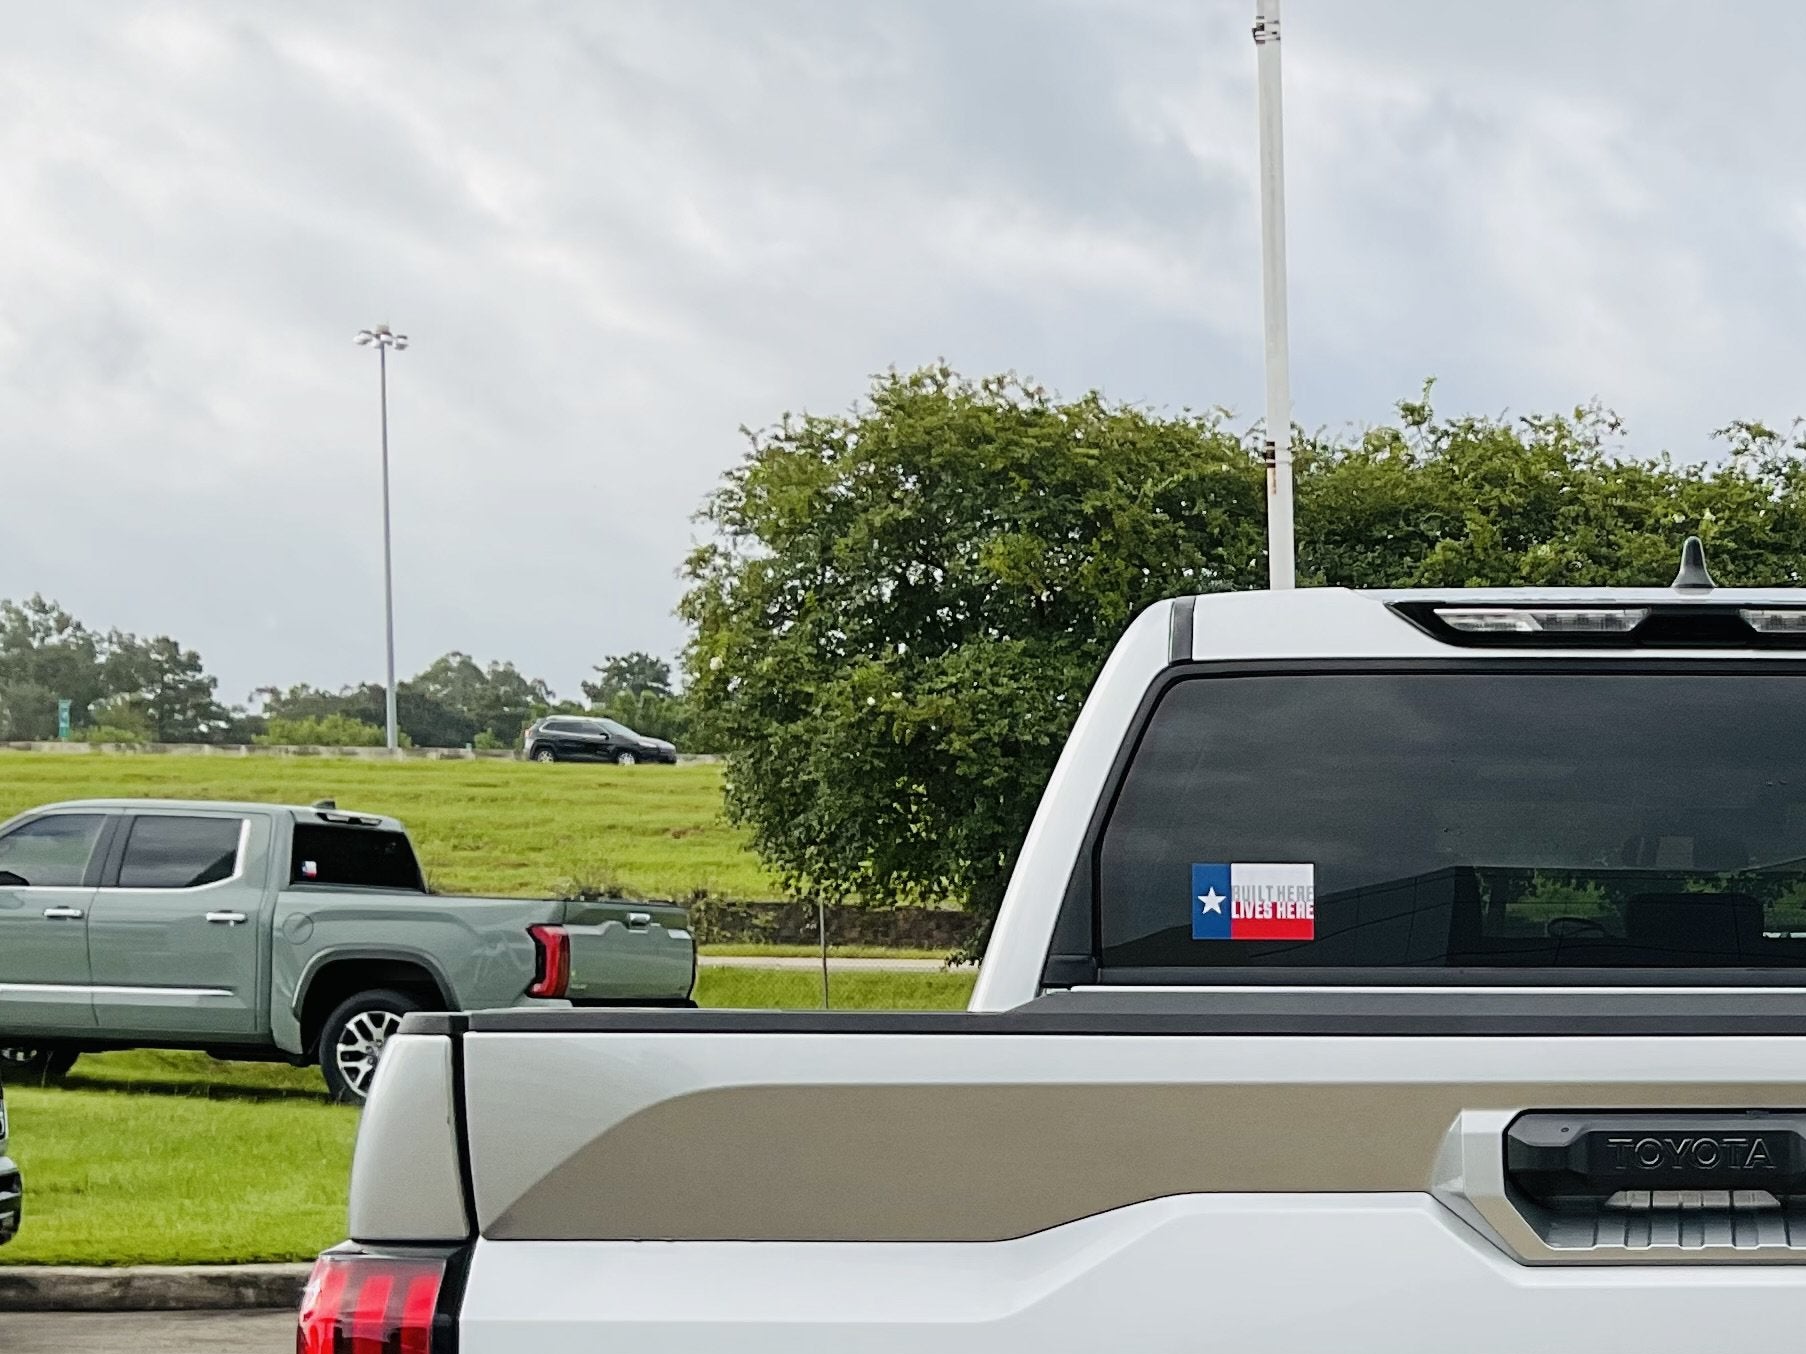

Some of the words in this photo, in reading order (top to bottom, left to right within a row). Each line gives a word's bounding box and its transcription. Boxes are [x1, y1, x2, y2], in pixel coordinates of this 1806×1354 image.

[1232, 884, 1273, 902] BUILT
[1277, 884, 1314, 902] HERE
[1231, 901, 1273, 919] LIVES
[1276, 901, 1314, 919] HERE
[1606, 1137, 1777, 1171] TOYOTA
